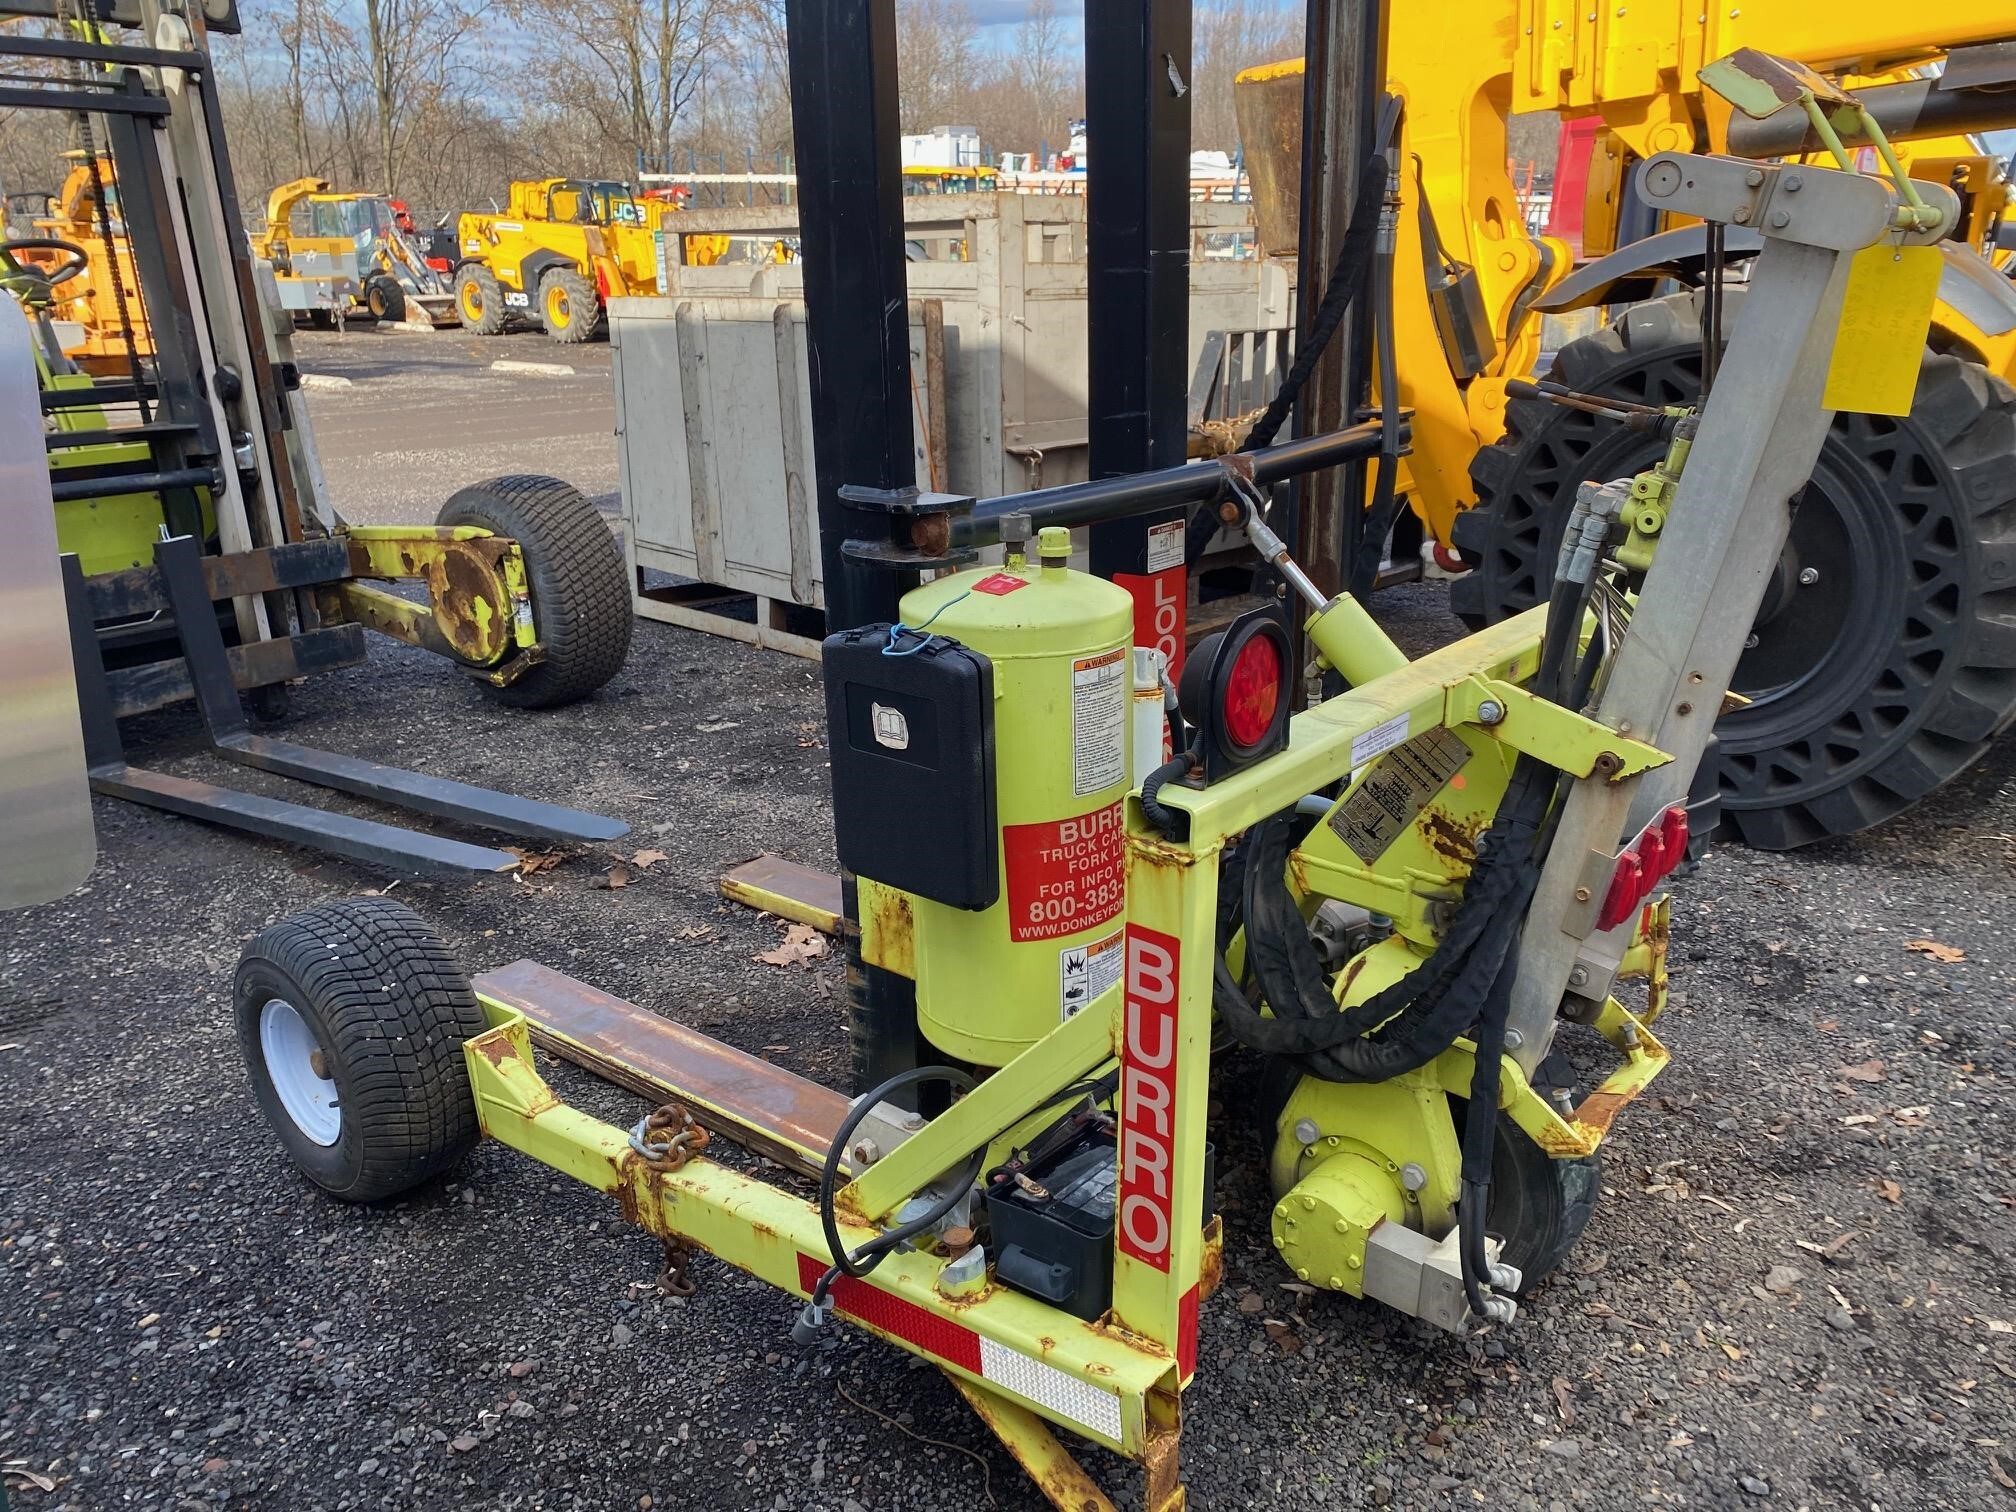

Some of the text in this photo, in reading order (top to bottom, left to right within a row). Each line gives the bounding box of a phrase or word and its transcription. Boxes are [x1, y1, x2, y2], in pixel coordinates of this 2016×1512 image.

[613, 202, 647, 222] JCB
[504, 291, 529, 307] JCB
[1091, 652, 1120, 667] WARNING
[1040, 838, 1097, 863] TRUCK
[1068, 849, 1109, 874] FORK
[1040, 880, 1075, 898] FOR
[1081, 865, 1113, 889] INFO
[1121, 935, 1175, 1255] BURRO
